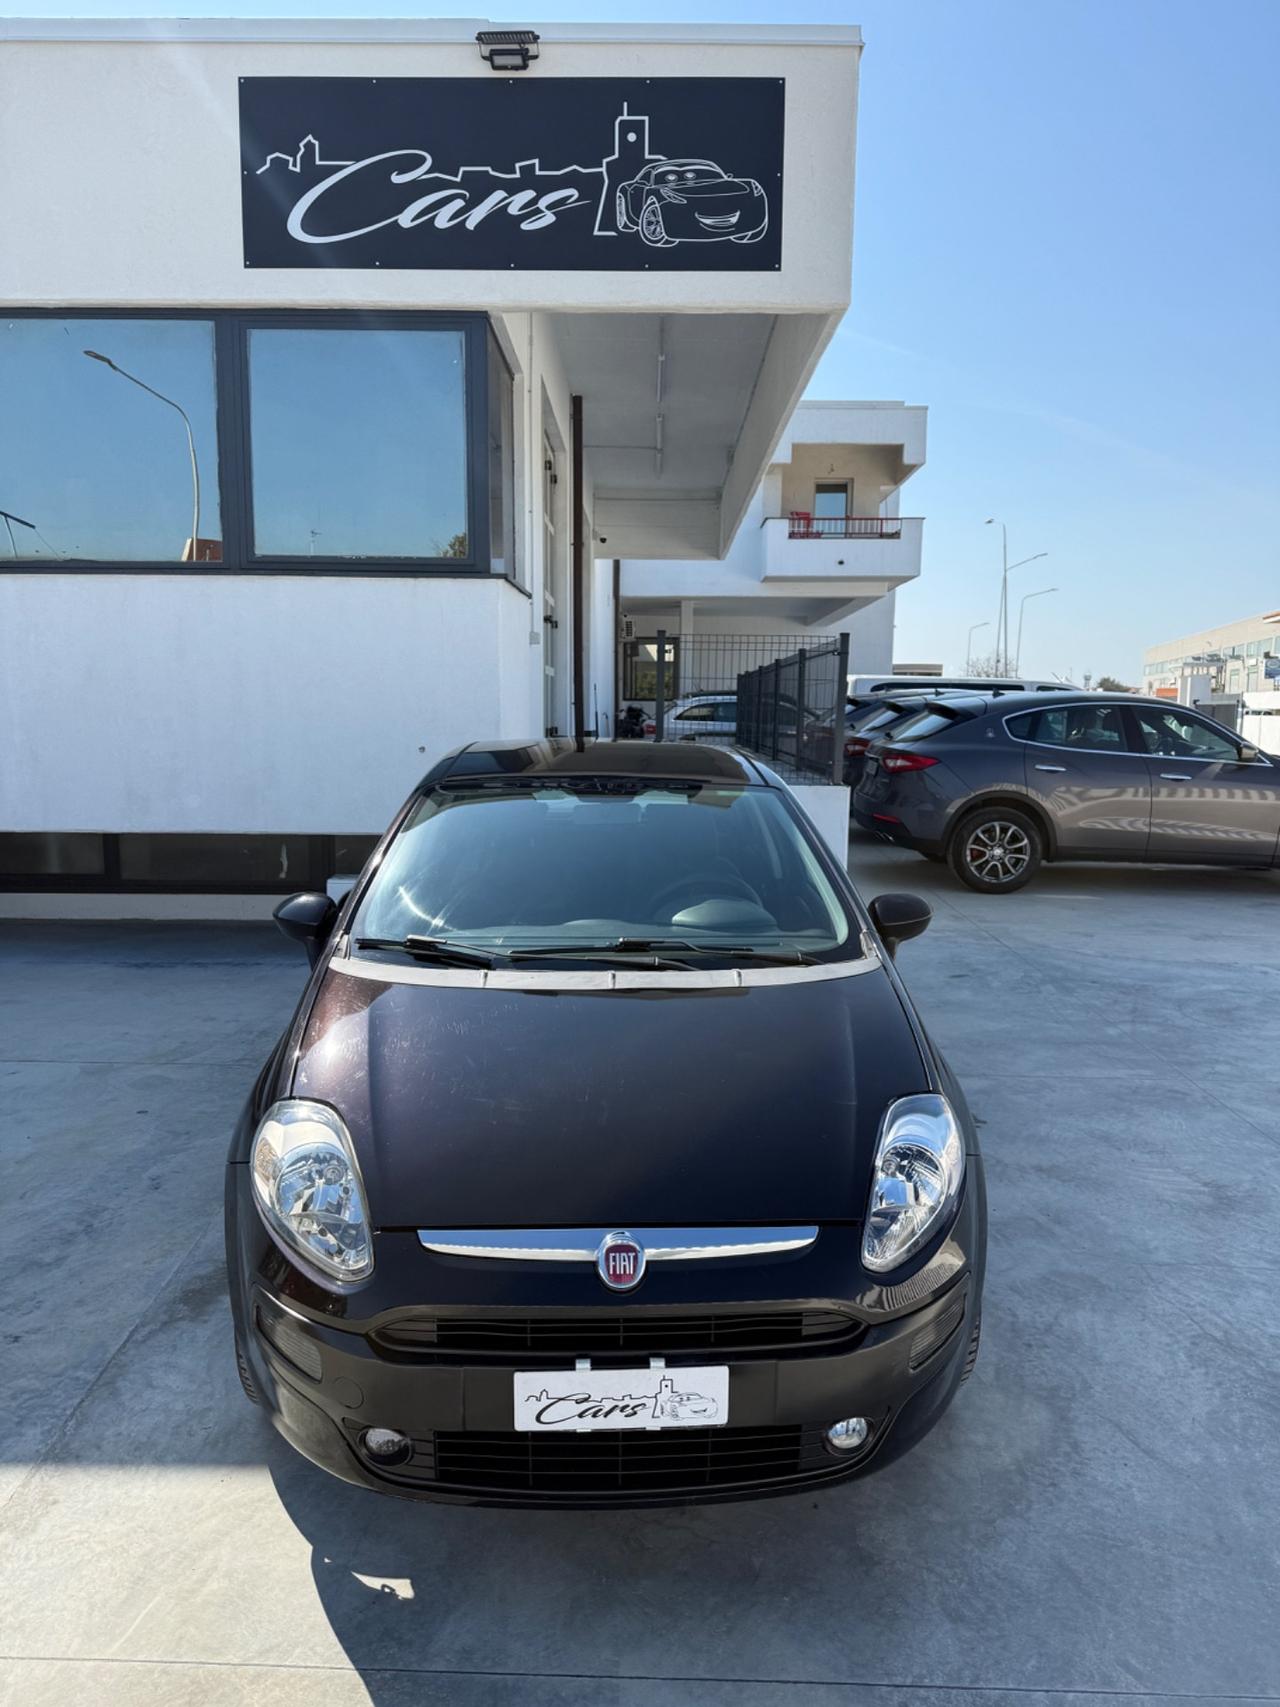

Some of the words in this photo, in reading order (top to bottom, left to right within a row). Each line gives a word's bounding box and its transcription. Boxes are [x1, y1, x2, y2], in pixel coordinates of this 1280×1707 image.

[287, 149, 590, 244] Cars
[609, 1252, 636, 1275] FIAT
[535, 1392, 649, 1425] Cars
